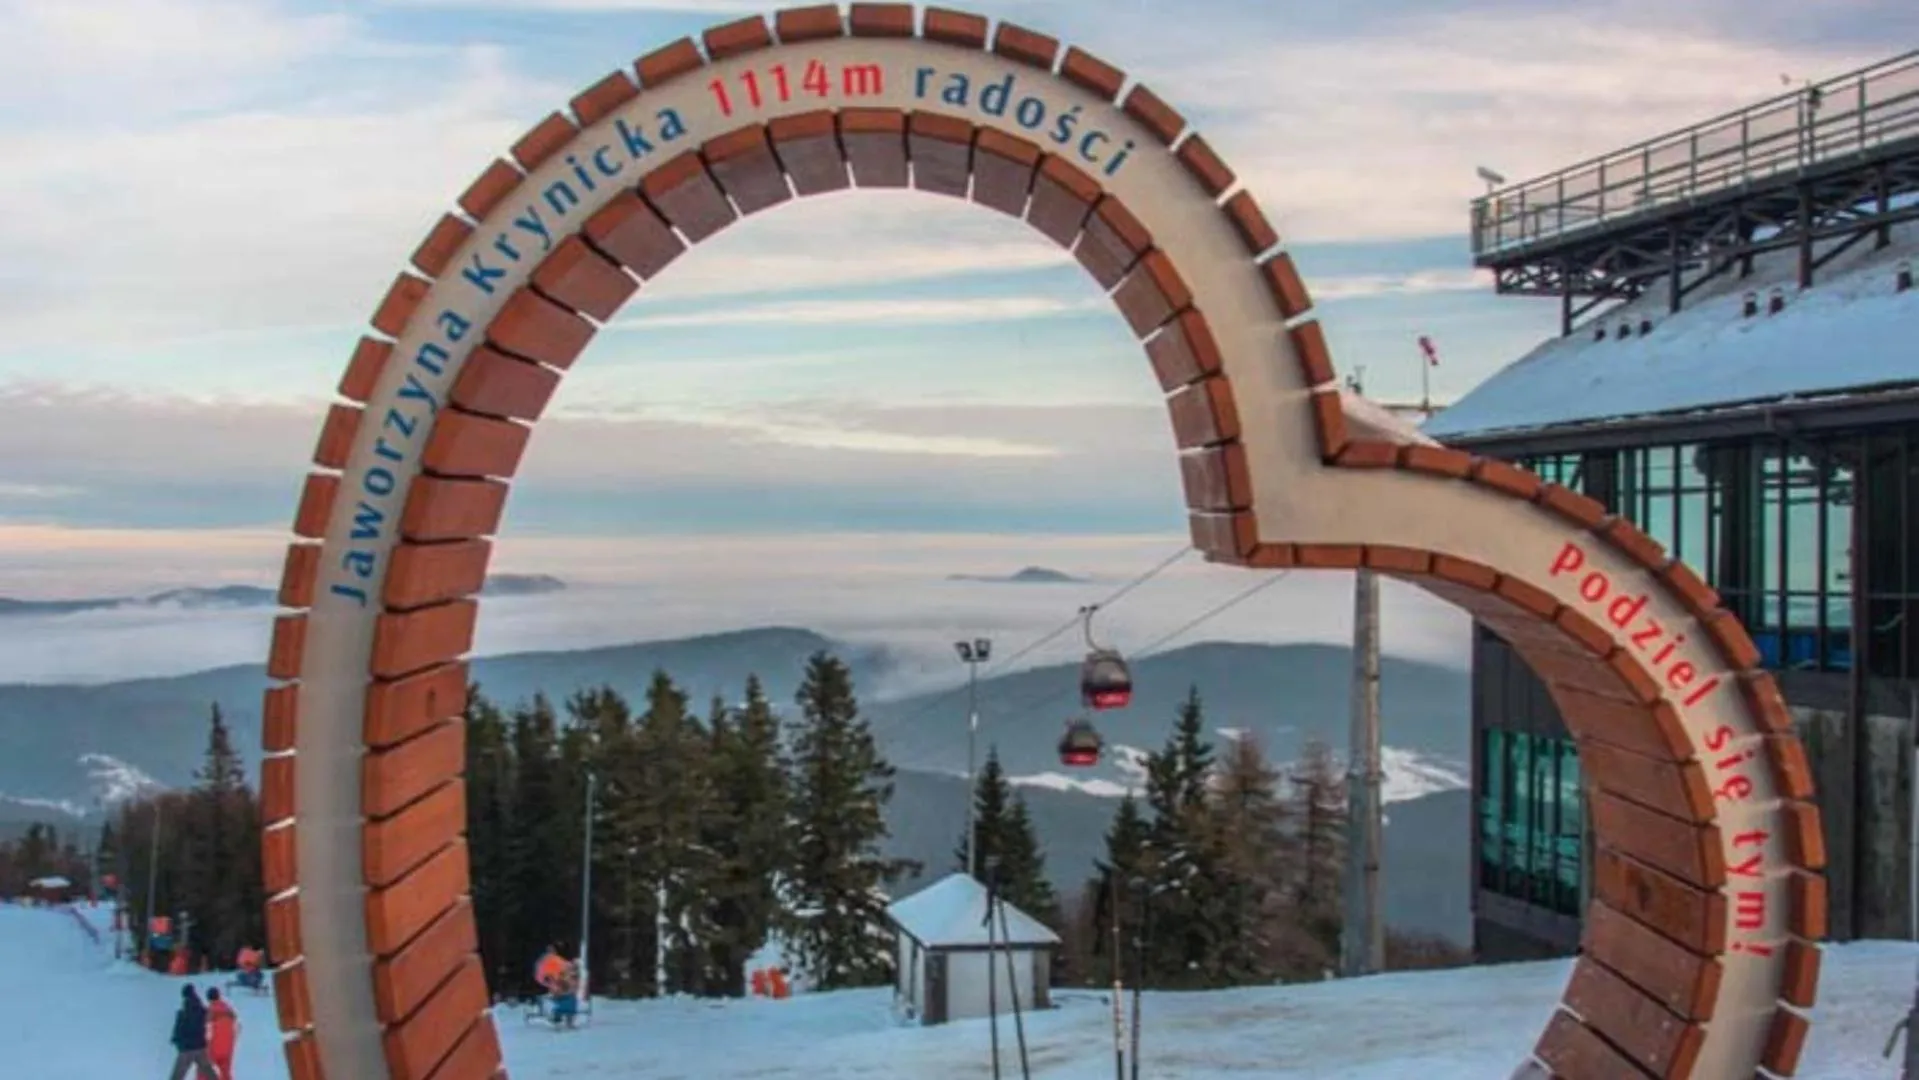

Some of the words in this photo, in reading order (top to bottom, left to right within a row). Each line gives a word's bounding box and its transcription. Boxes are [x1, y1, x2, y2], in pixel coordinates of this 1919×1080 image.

[331, 309, 472, 607] Jaworzyna
[461, 107, 686, 294] Krynicka
[708, 59, 884, 117] 1114m
[914, 63, 1136, 175] radości
[1703, 723, 1757, 804] się
[1727, 827, 1774, 958] tym!
